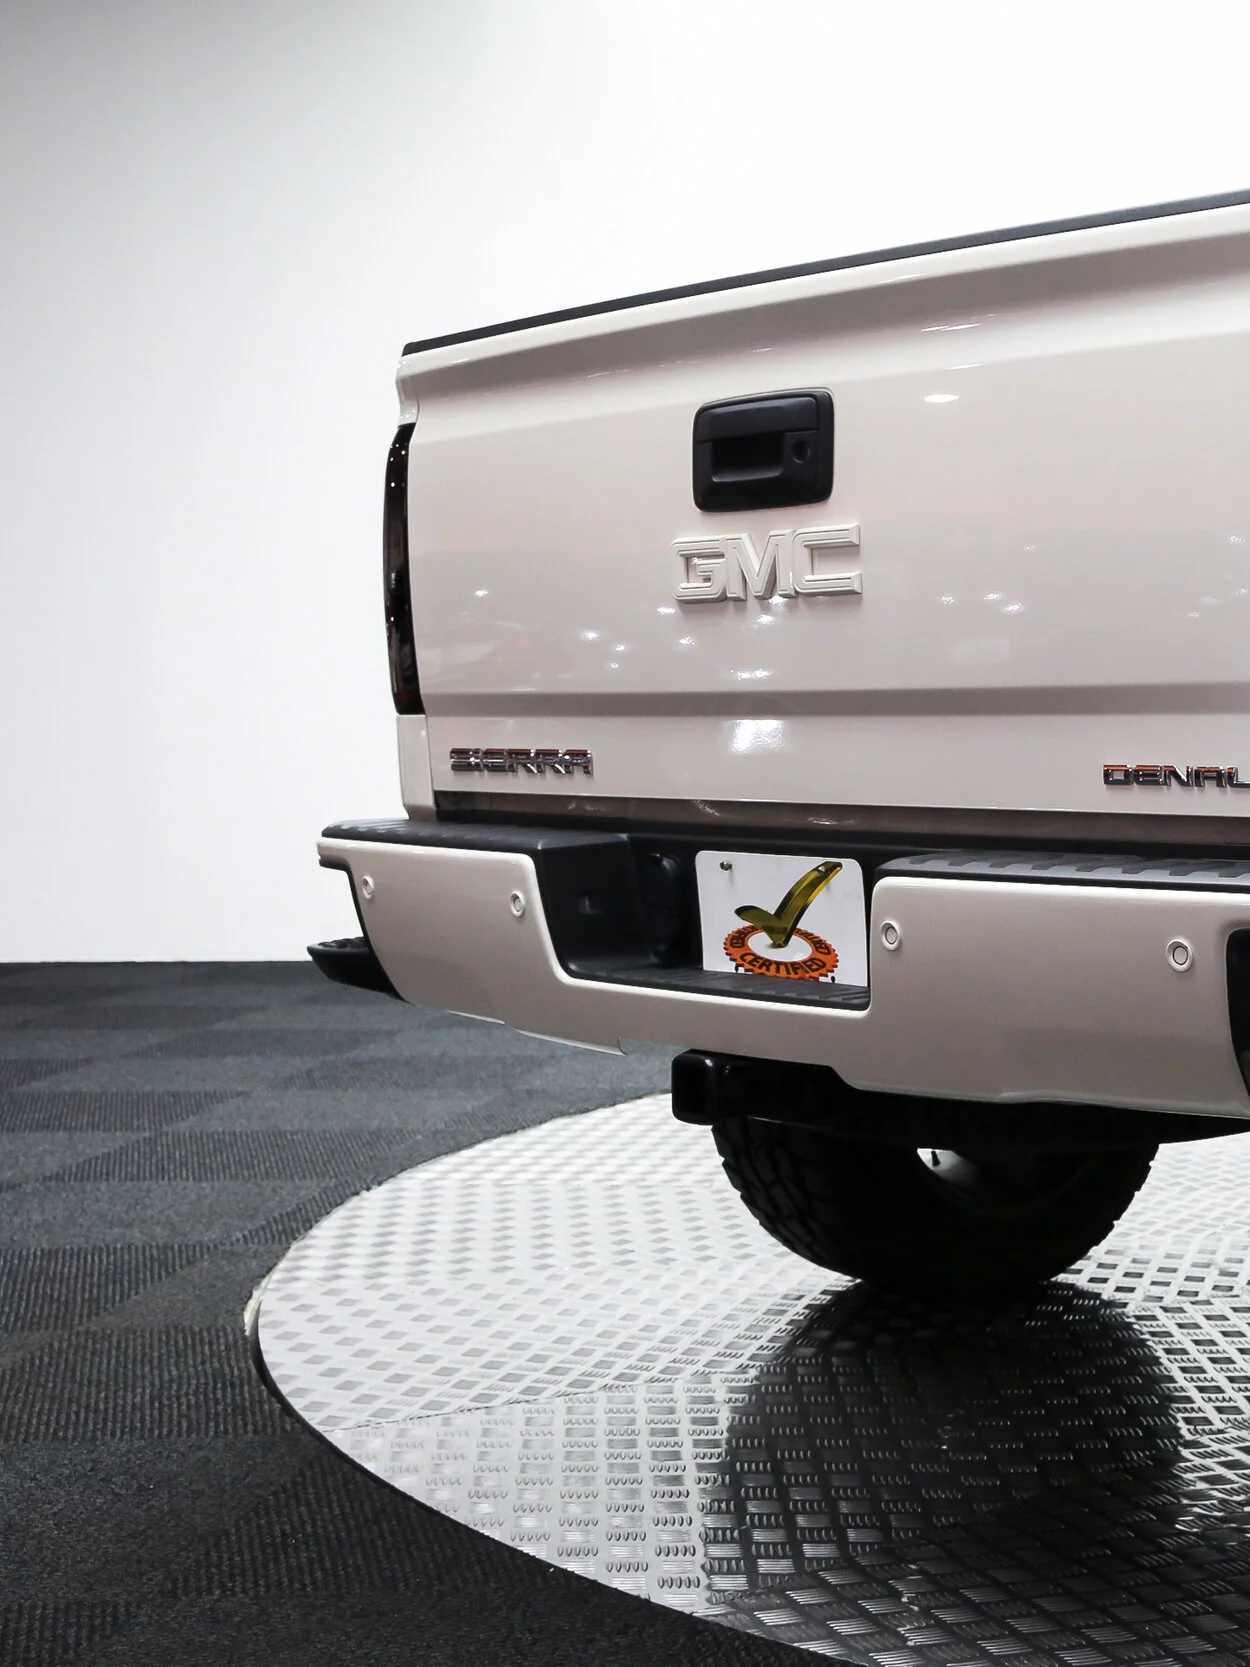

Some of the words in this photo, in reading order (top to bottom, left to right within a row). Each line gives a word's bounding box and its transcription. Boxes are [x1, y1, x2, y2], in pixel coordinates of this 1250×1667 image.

[672, 524, 862, 603] GMC
[450, 748, 593, 775] SIERRA
[741, 953, 826, 975] CERTIFIED
